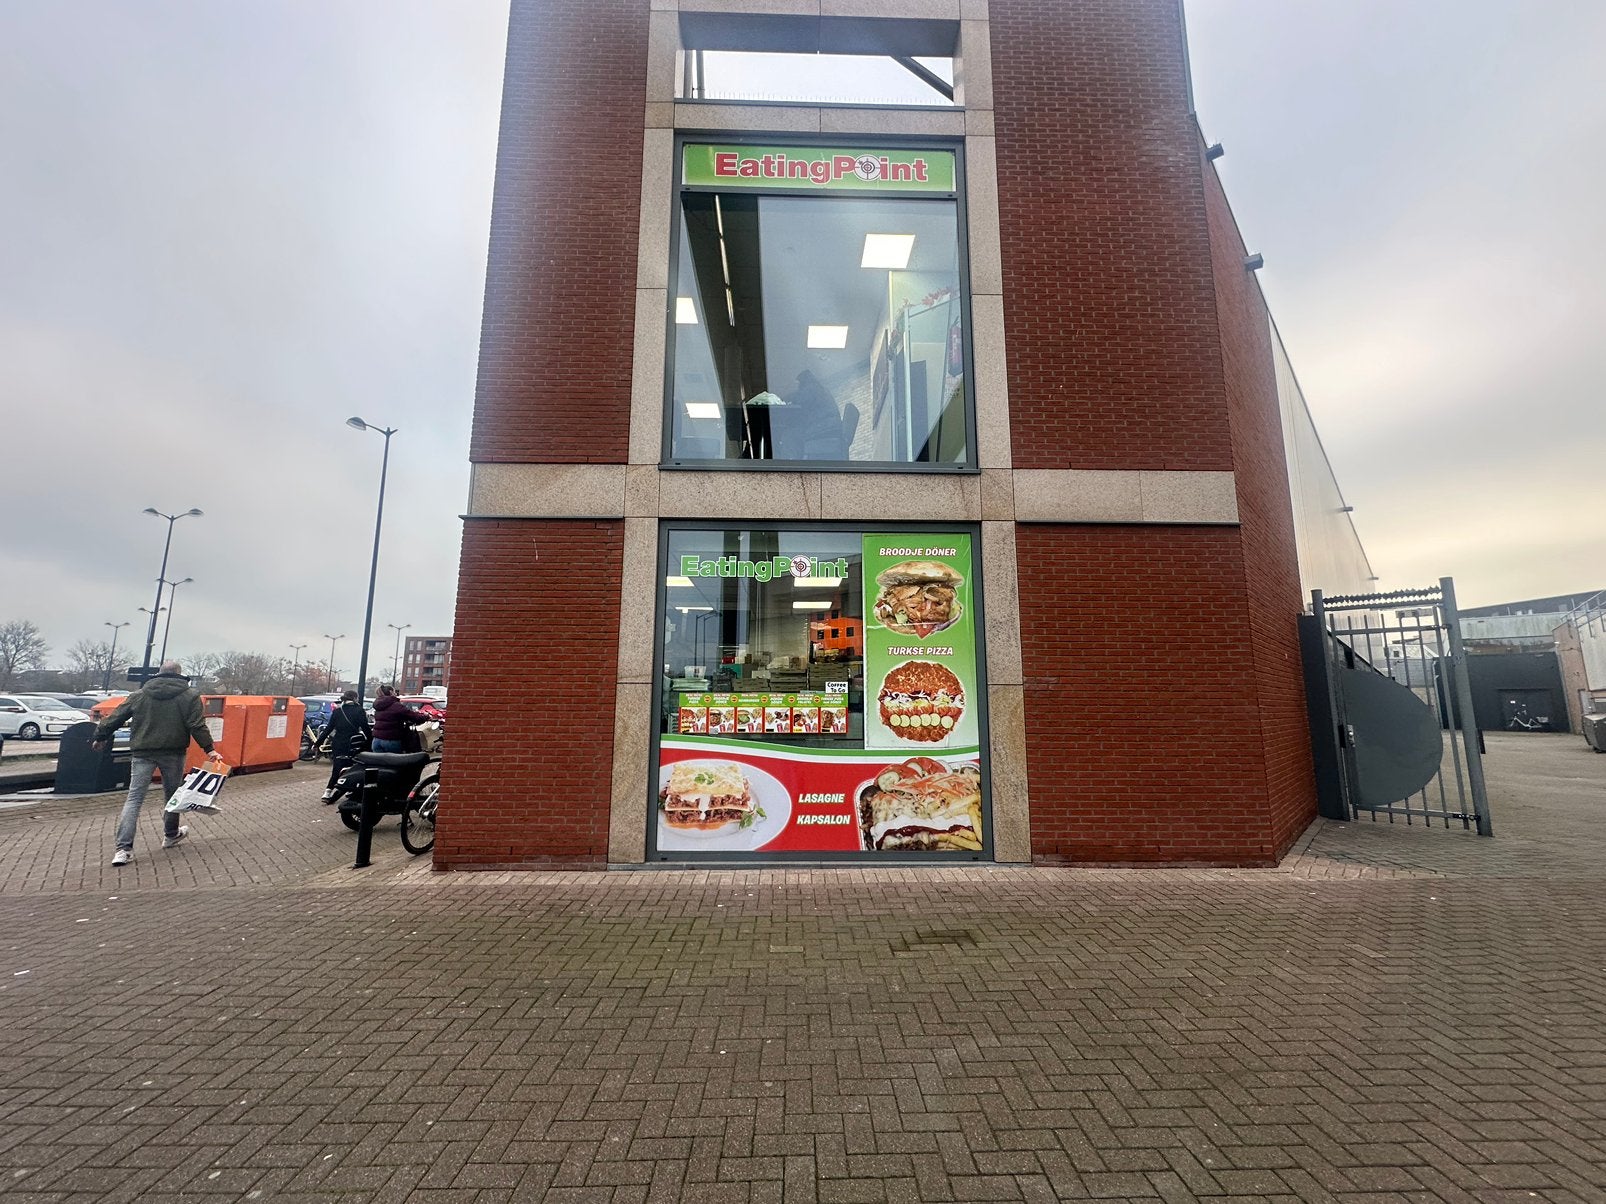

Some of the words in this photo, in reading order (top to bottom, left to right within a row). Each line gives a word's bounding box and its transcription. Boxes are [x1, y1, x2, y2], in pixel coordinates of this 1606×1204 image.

[714, 152, 928, 184] EatingPoint
[879, 547, 923, 556] BROODJE
[925, 546, 957, 556] DÖNER
[680, 554, 848, 582] EatingPoint
[888, 647, 927, 656] TURKSE
[926, 647, 954, 656] PIZZA
[798, 793, 846, 803] LASAGNE
[796, 814, 851, 825] KAPSALON
